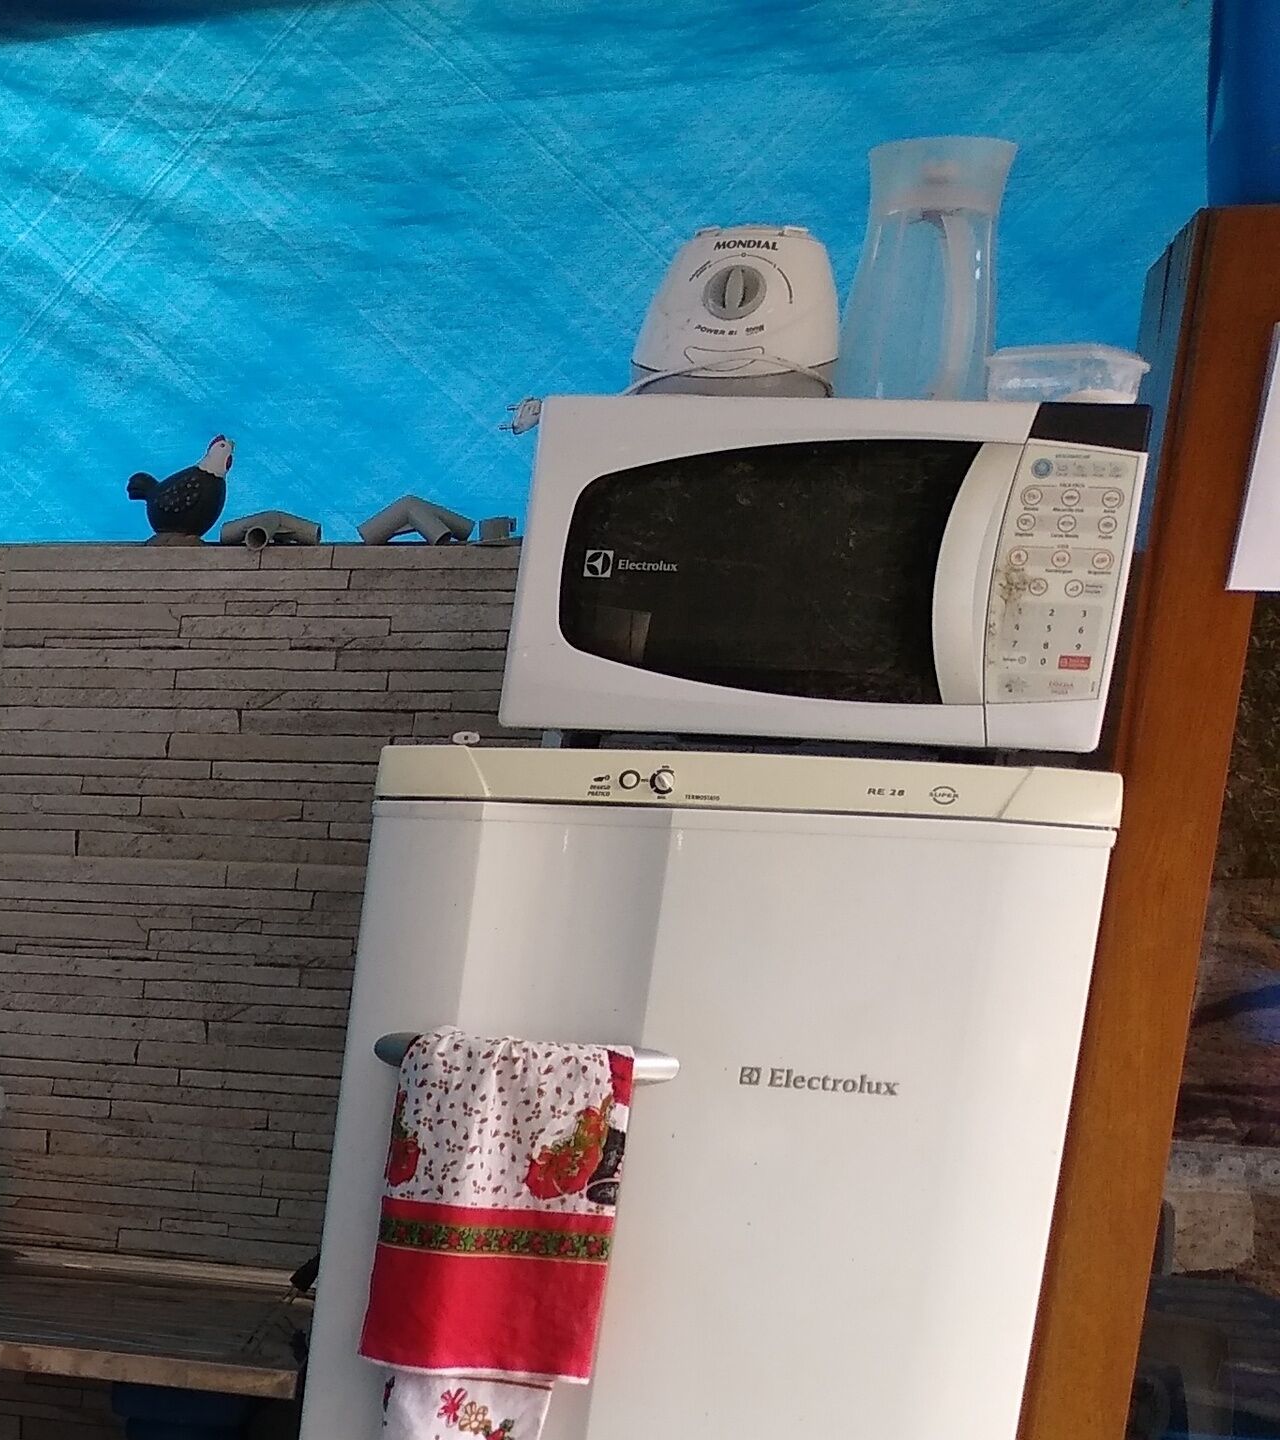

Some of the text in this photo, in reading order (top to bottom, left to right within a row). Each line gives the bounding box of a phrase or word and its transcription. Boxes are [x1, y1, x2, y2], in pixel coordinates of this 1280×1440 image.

[713, 239, 779, 251] MONDIAL
[617, 559, 678, 572] Electrolux
[1048, 608, 1055, 617] 2
[1081, 609, 1087, 618] 3
[1046, 624, 1052, 632] 5
[1078, 626, 1084, 634] 6
[1012, 640, 1018, 648] 7
[1042, 641, 1049, 650] 8
[867, 787, 905, 797] RE 28
[767, 1067, 900, 1096] Electrolux
